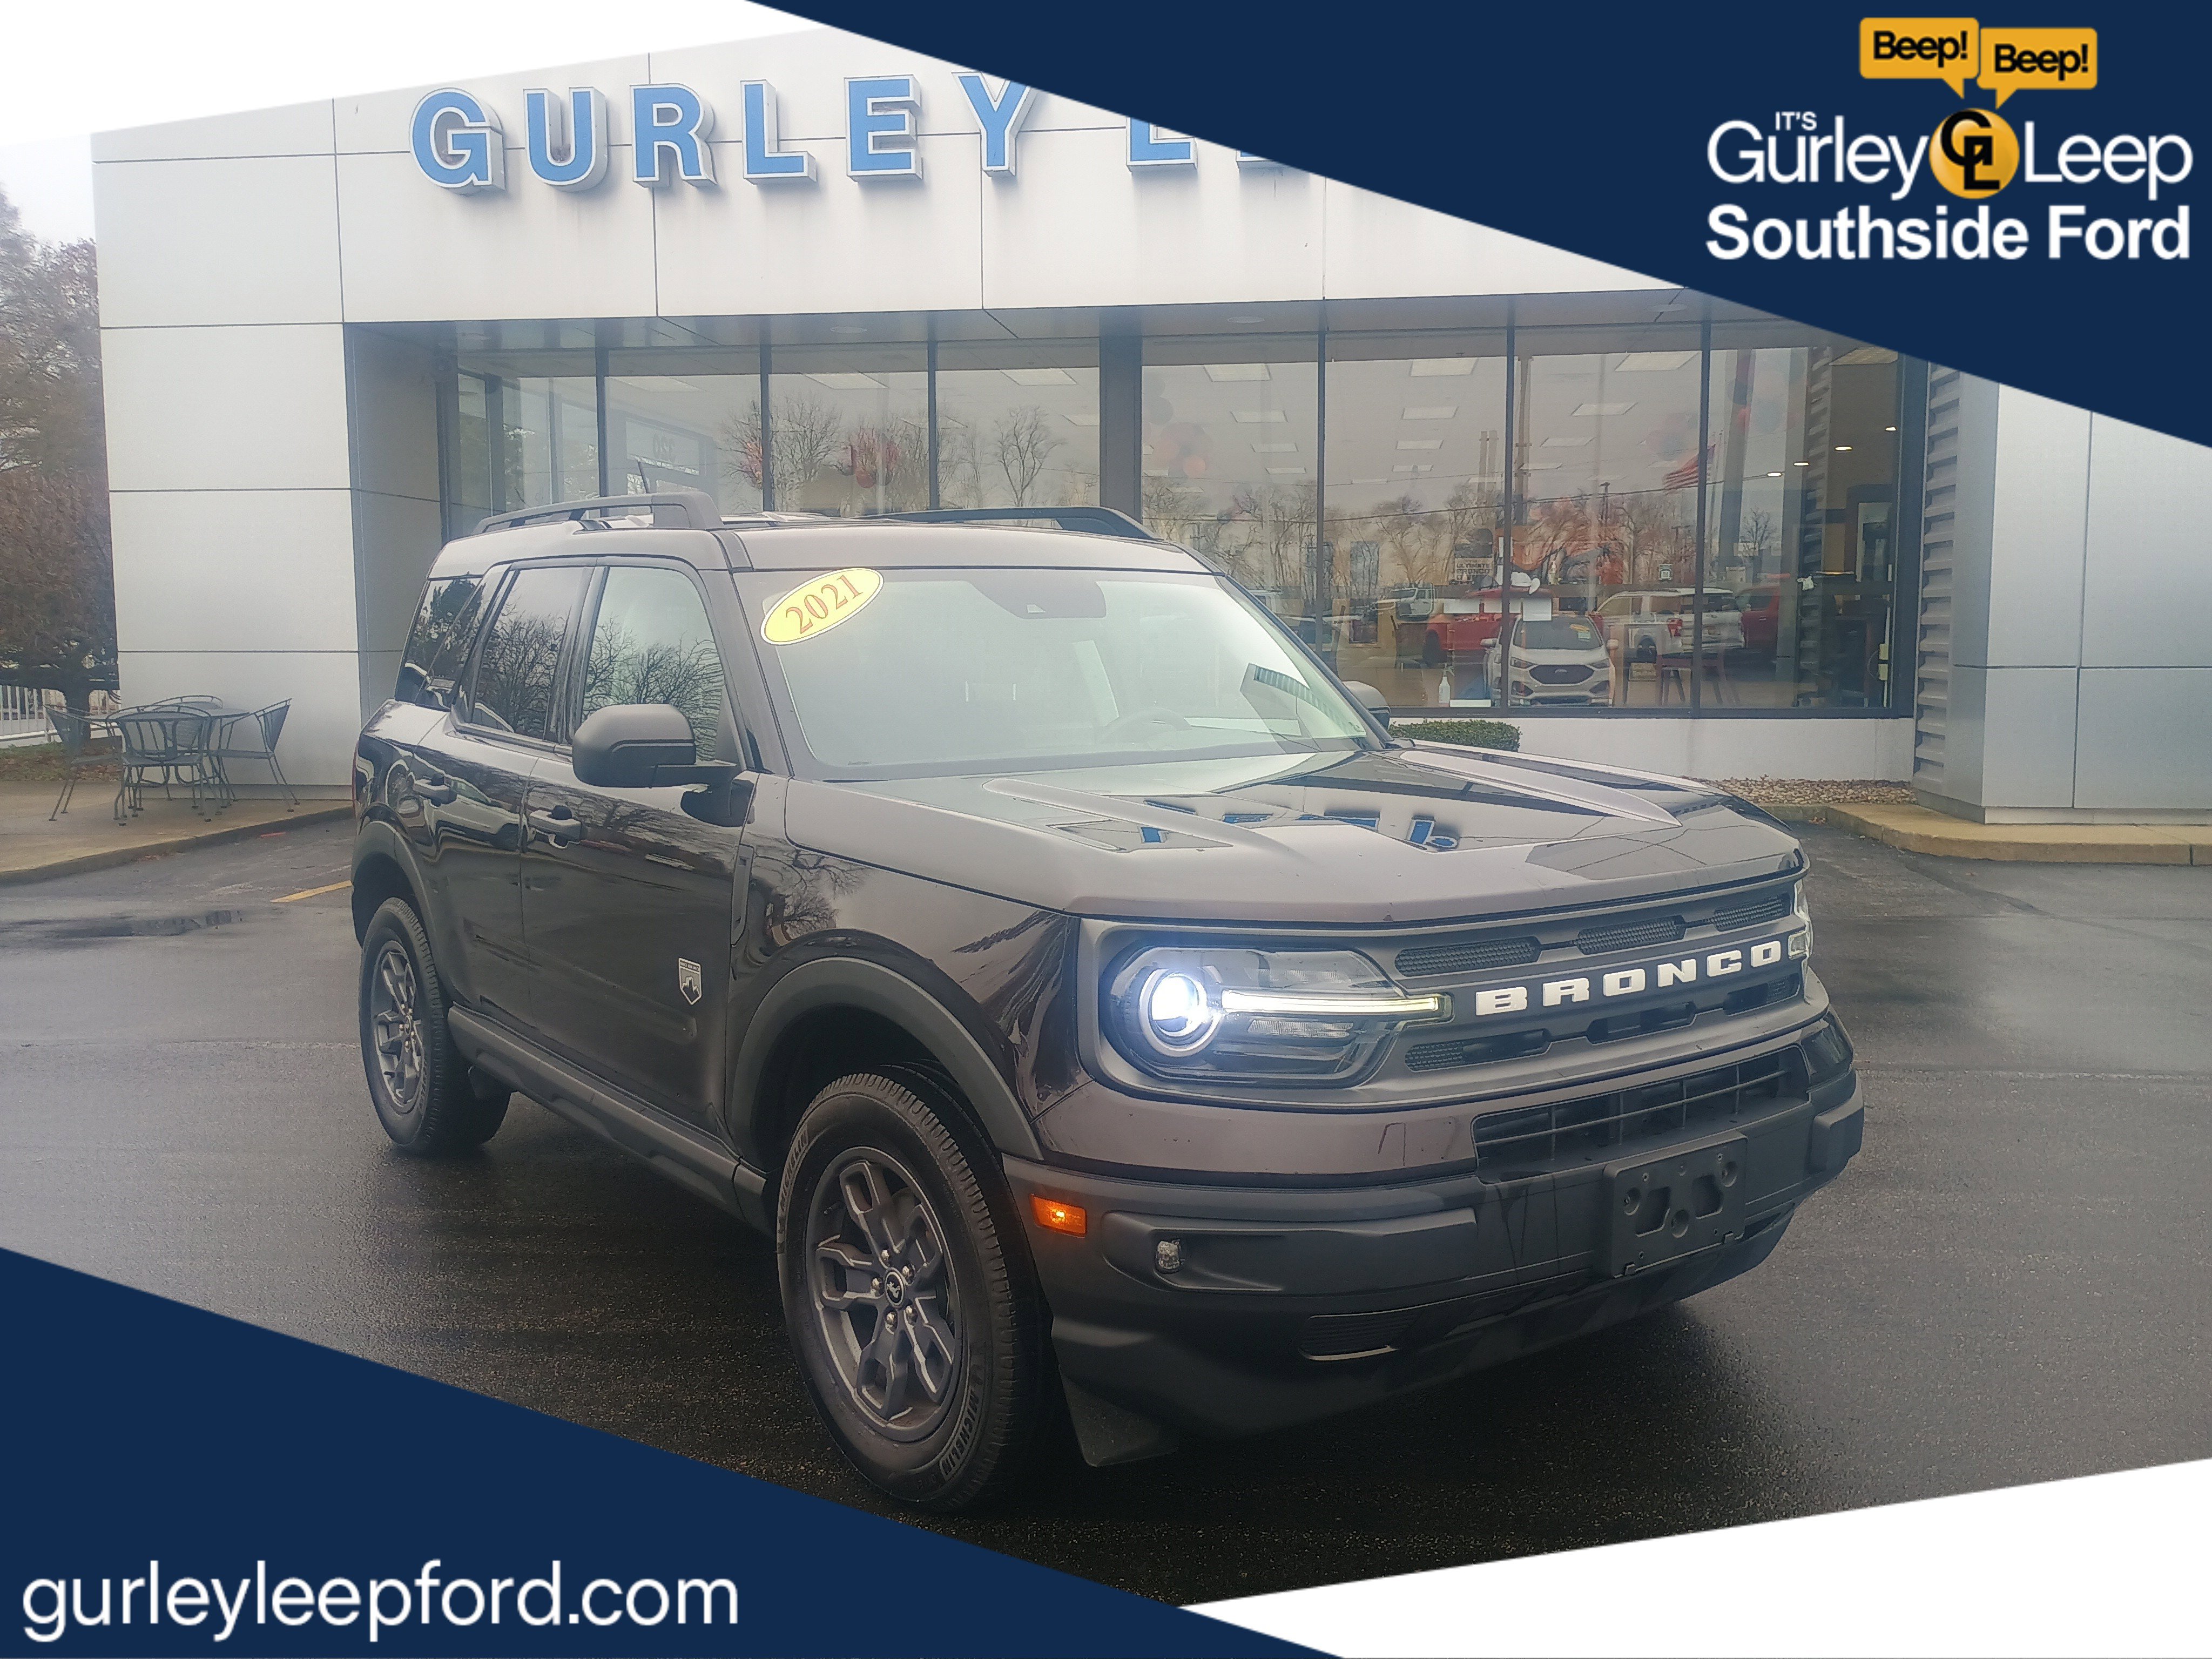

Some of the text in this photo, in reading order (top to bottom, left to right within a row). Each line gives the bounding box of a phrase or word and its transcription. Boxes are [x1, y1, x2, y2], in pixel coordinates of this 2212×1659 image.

[409, 72, 1040, 195] GURLEY
[786, 574, 864, 635] 2021
[1475, 940, 1781, 1016] BRONCO
[779, 1129, 809, 1212] MICHELIN
[941, 1388, 980, 1476] MICHELIN
